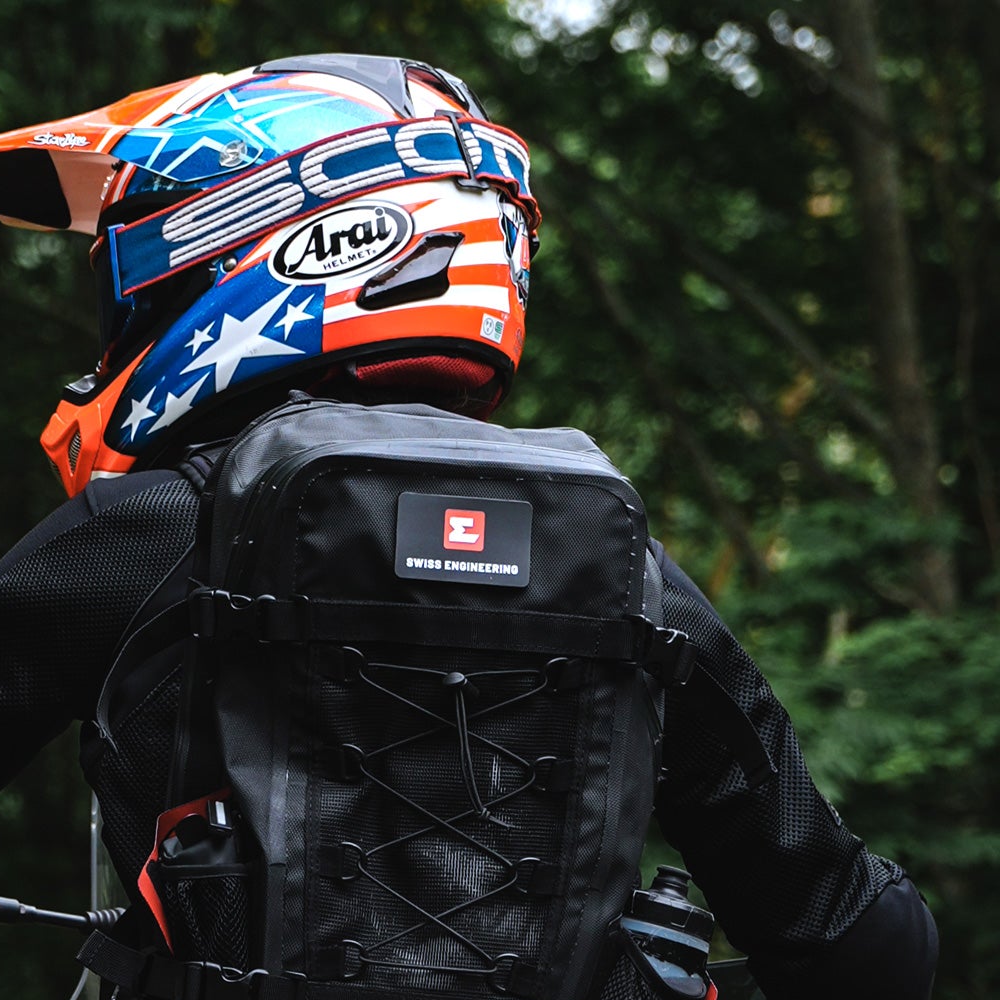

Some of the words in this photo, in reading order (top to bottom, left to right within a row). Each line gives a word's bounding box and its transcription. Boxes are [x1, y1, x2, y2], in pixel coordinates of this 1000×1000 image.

[286, 207, 392, 274] Arai
[323, 248, 374, 271] HELMET
[405, 557, 442, 570] SWISS
[444, 560, 519, 575] ENGINEERING
